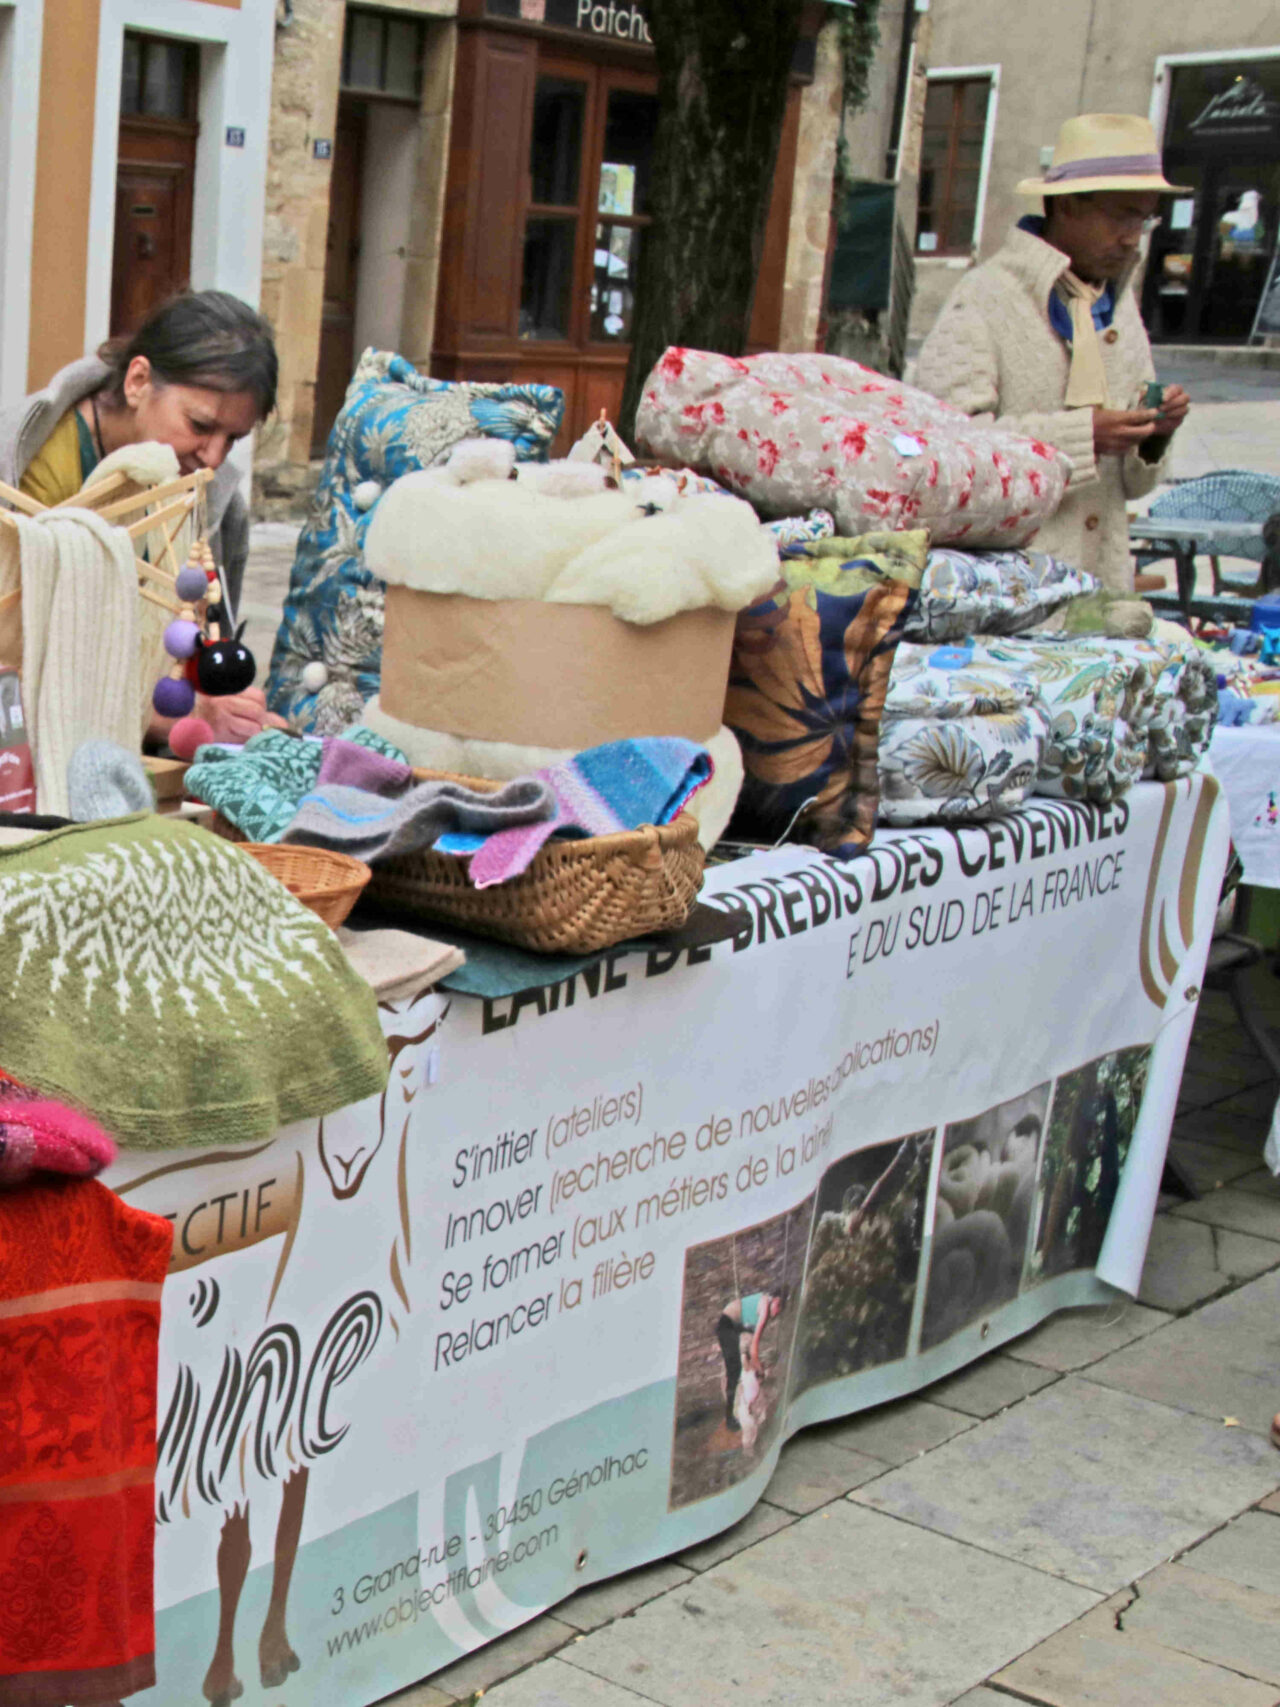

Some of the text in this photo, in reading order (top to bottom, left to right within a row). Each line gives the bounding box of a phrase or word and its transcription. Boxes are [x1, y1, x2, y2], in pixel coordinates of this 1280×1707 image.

[862, 911, 902, 964] DU
[905, 899, 965, 951] SUD
[971, 886, 1005, 936] DE
[1008, 878, 1034, 924] LA
[1040, 850, 1126, 915] FRANCE
[867, 834, 944, 902] DES
[444, 1184, 544, 1251] Innover
[549, 1130, 687, 1214] (recherche
[694, 1113, 733, 1152] de
[739, 1077, 831, 1139] nouvelles
[544, 1081, 644, 1161] (ateliers)
[439, 1270, 473, 1311] Se
[481, 1230, 566, 1292] former
[571, 1206, 628, 1260] (aux
[634, 1170, 729, 1229] métiers
[735, 1154, 769, 1193] de
[776, 1143, 797, 1178] la
[433, 1250, 656, 1371] Relancer la filière
[326, 1523, 560, 1658] www.objectiflaine.com
[330, 1586, 345, 1616] 3
[352, 1532, 462, 1605] Grand-rue
[483, 1488, 543, 1542] 30450
[546, 1447, 649, 1506] Génolhac
